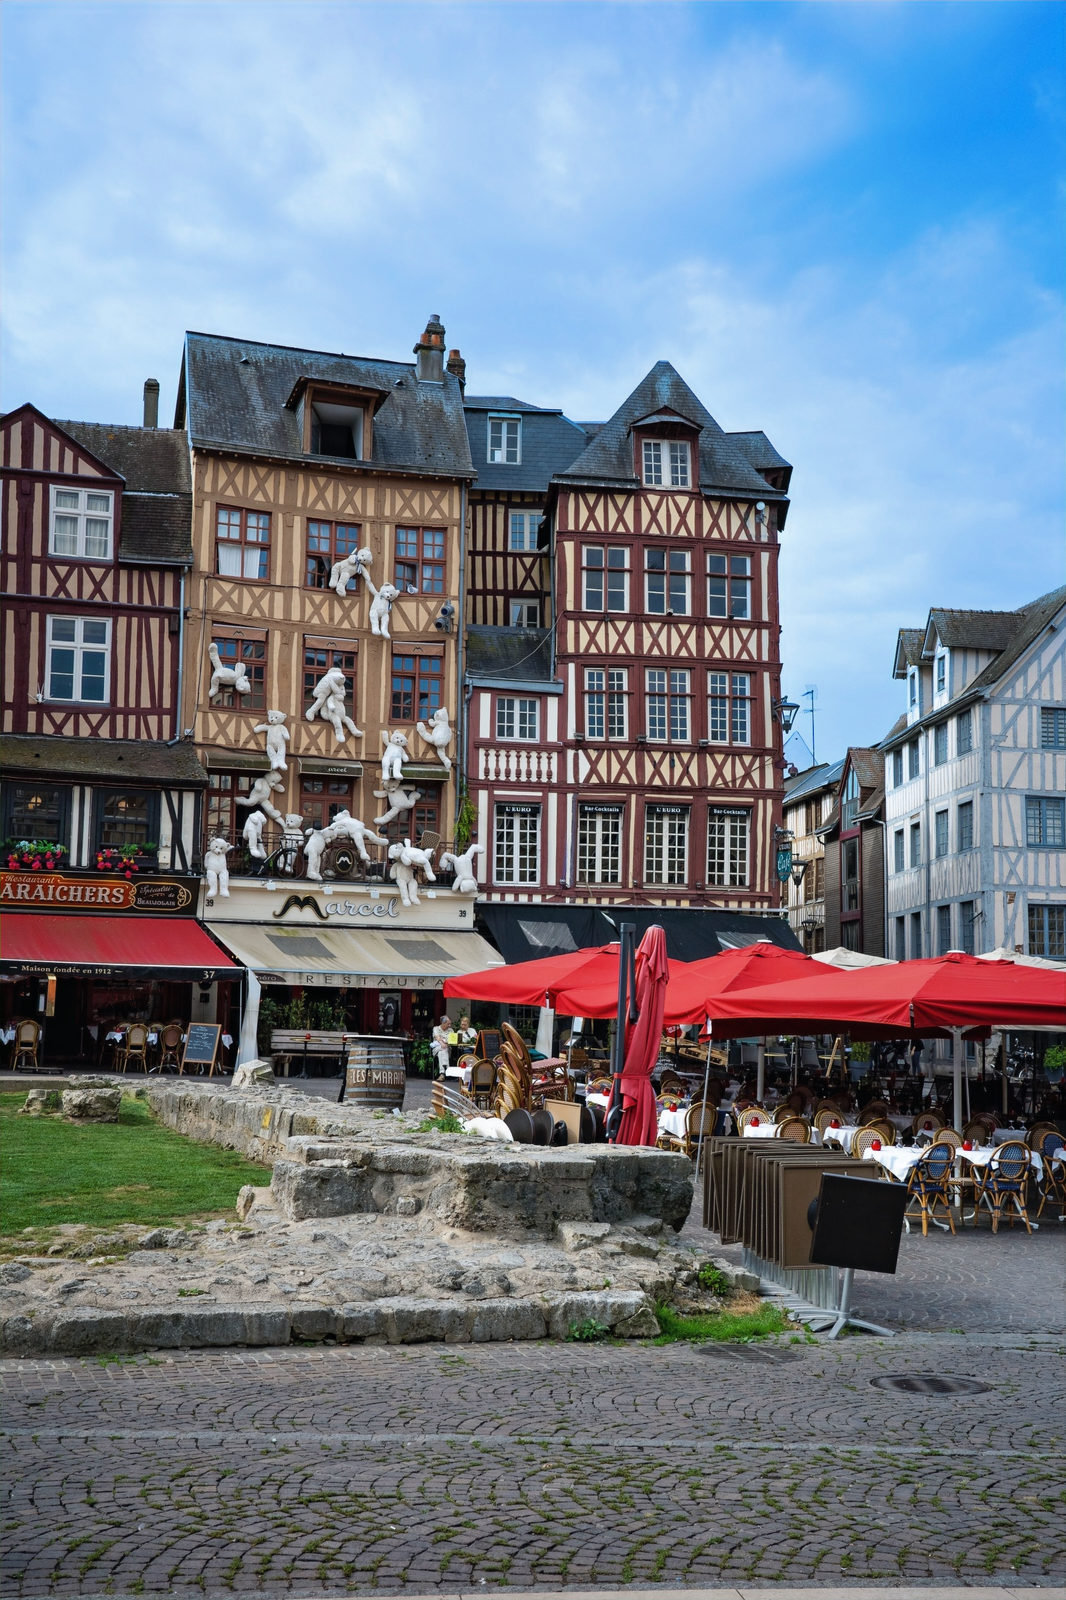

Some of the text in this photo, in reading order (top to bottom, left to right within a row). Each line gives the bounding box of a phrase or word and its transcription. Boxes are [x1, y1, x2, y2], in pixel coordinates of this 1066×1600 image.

[4, 874, 55, 884] Restaurant
[137, 898, 176, 906] BEAUJOLAIS
[205, 898, 214, 907] 39
[458, 909, 467, 918] 39
[21, 964, 51, 973] Maison
[53, 966, 80, 974] fondée
[202, 970, 216, 979] 37
[351, 1068, 366, 1084] LES
